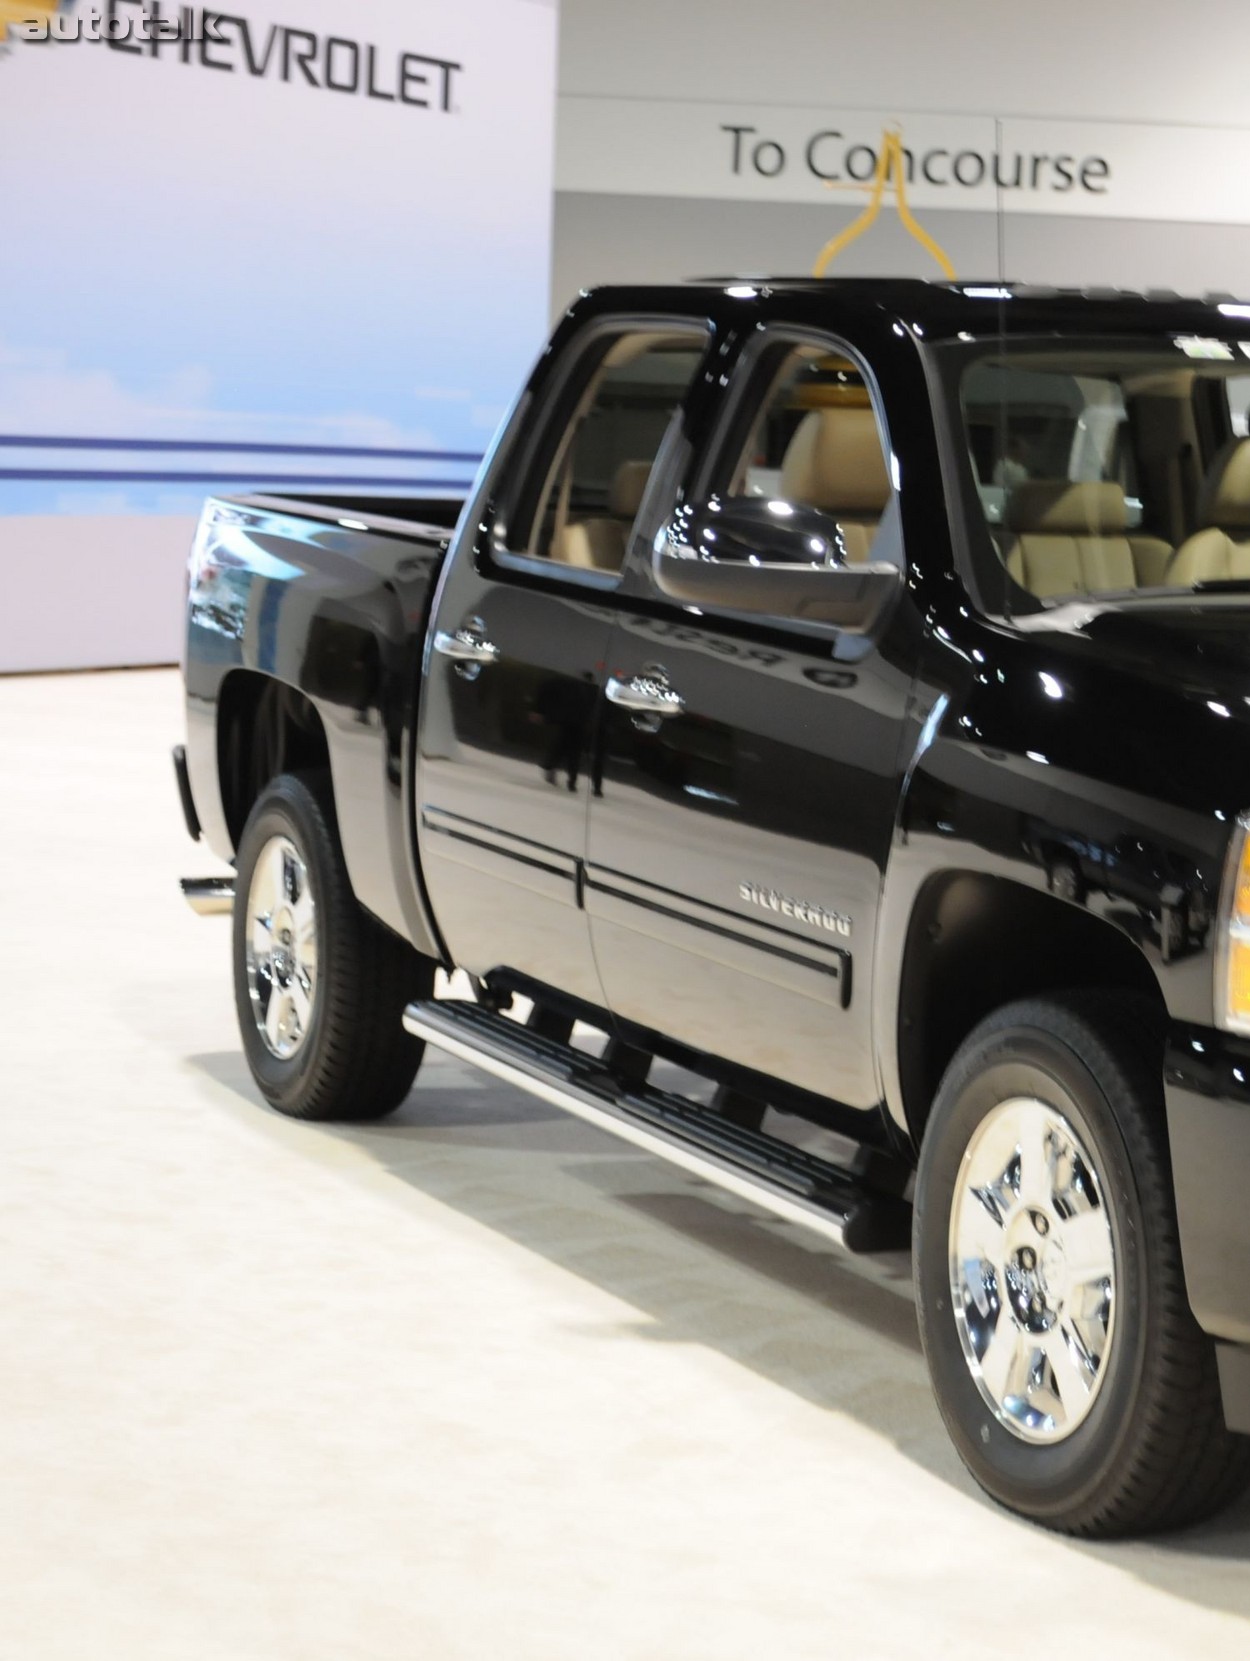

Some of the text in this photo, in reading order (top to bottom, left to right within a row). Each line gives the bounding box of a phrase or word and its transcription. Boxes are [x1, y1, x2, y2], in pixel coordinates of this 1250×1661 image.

[107, 0, 461, 112] CHEVROLET
[721, 124, 1110, 193] To Concourse
[739, 884, 852, 936] SILVERADO
